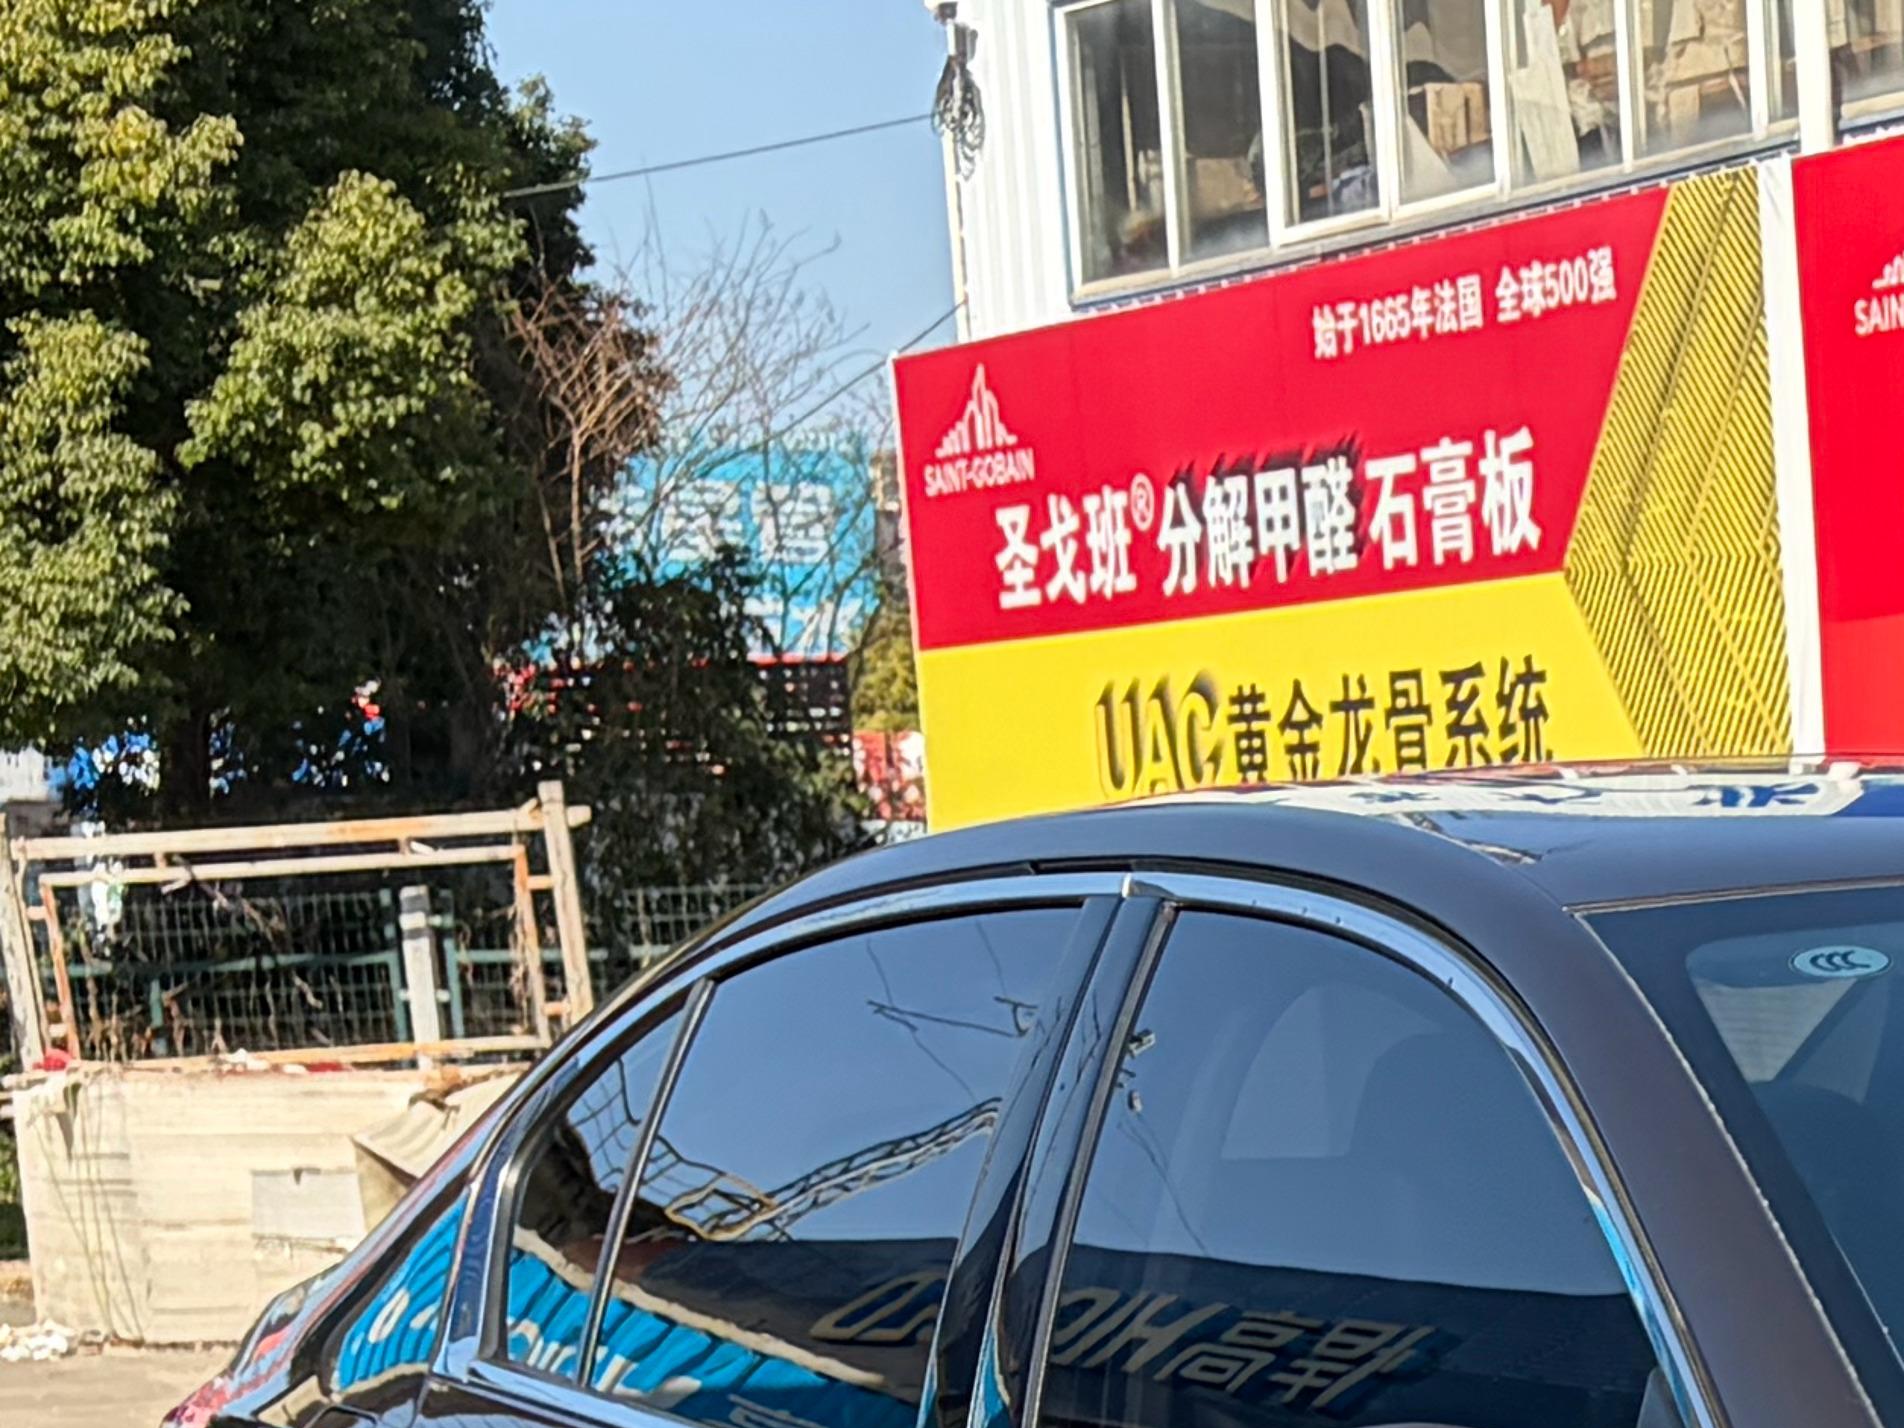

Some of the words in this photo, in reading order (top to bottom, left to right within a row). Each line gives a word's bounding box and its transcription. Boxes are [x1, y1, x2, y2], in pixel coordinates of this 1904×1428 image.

[1312, 274, 1484, 359] 始于1665年法国
[1495, 246, 1618, 322] 全球500强
[924, 448, 1034, 498] SAINT-GOBAIN
